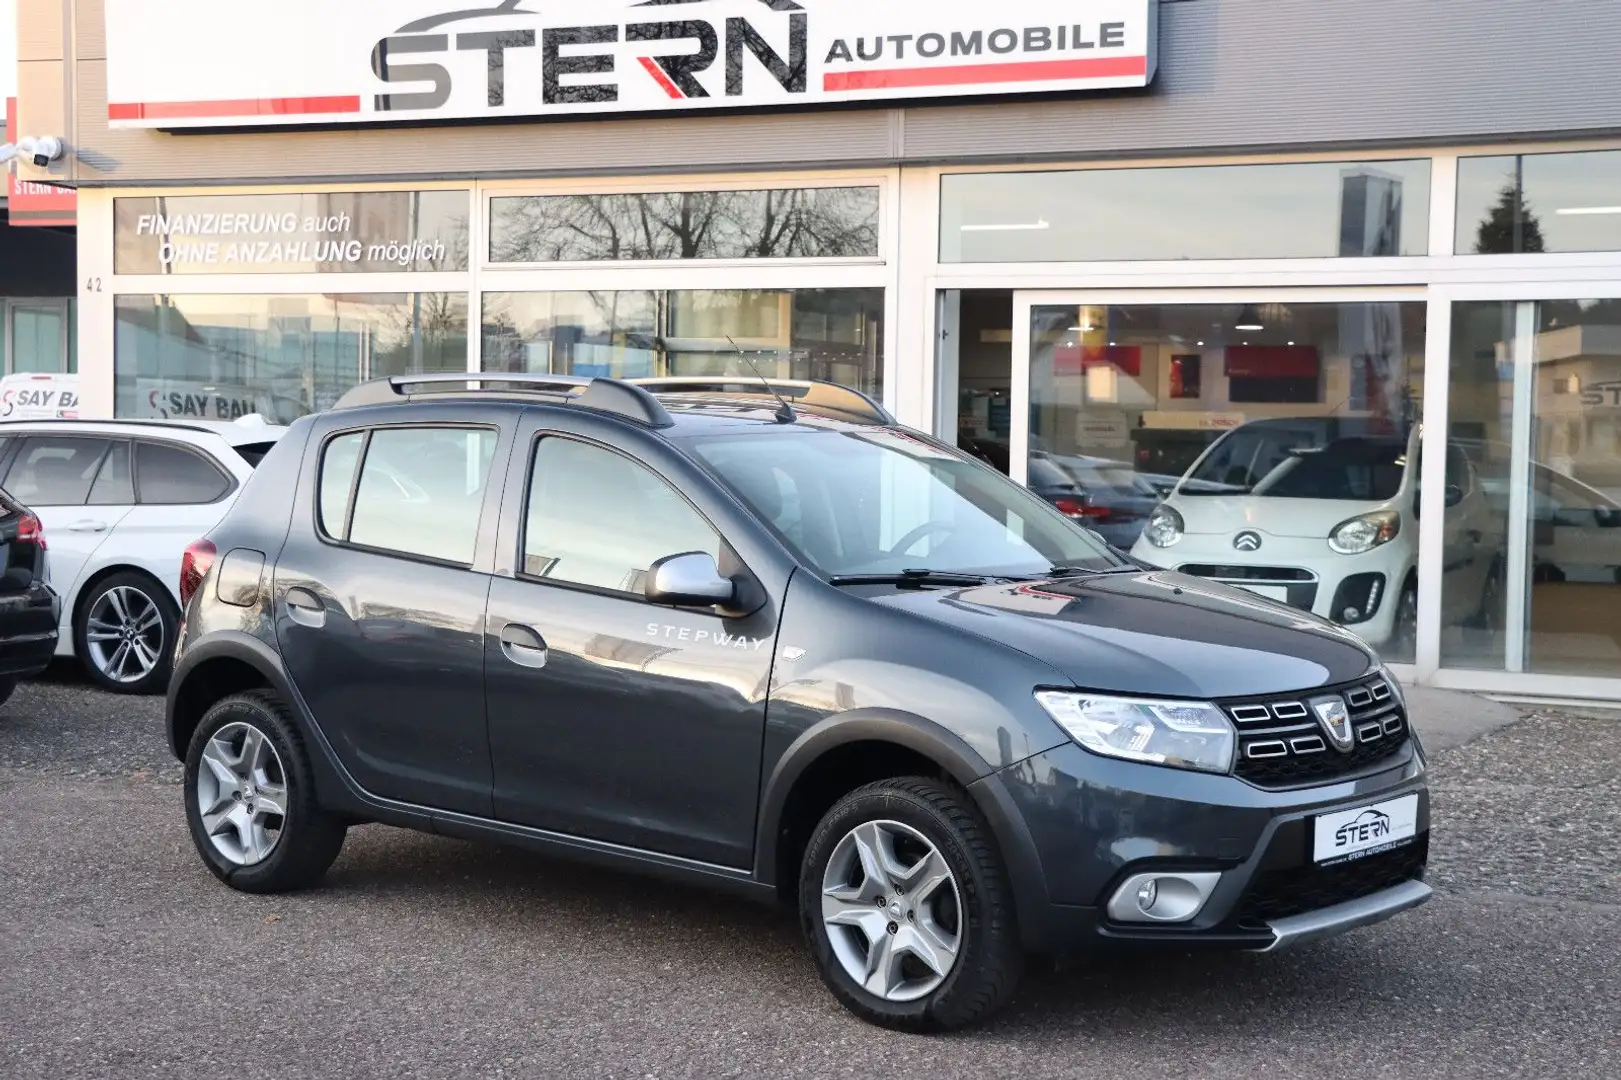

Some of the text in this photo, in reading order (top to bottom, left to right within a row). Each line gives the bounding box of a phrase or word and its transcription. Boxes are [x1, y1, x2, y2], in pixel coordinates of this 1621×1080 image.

[371, 13, 1125, 112] STERN AUTOMOBILE
[136, 211, 351, 235] FINANZIERUNG auch
[159, 239, 445, 266] OHNE ANZAHLUNG möglich
[87, 277, 102, 293] 42
[17, 389, 55, 406] SAY
[169, 391, 208, 417] SAY
[646, 623, 763, 650] STEPWAY
[1335, 818, 1389, 847] STERN
